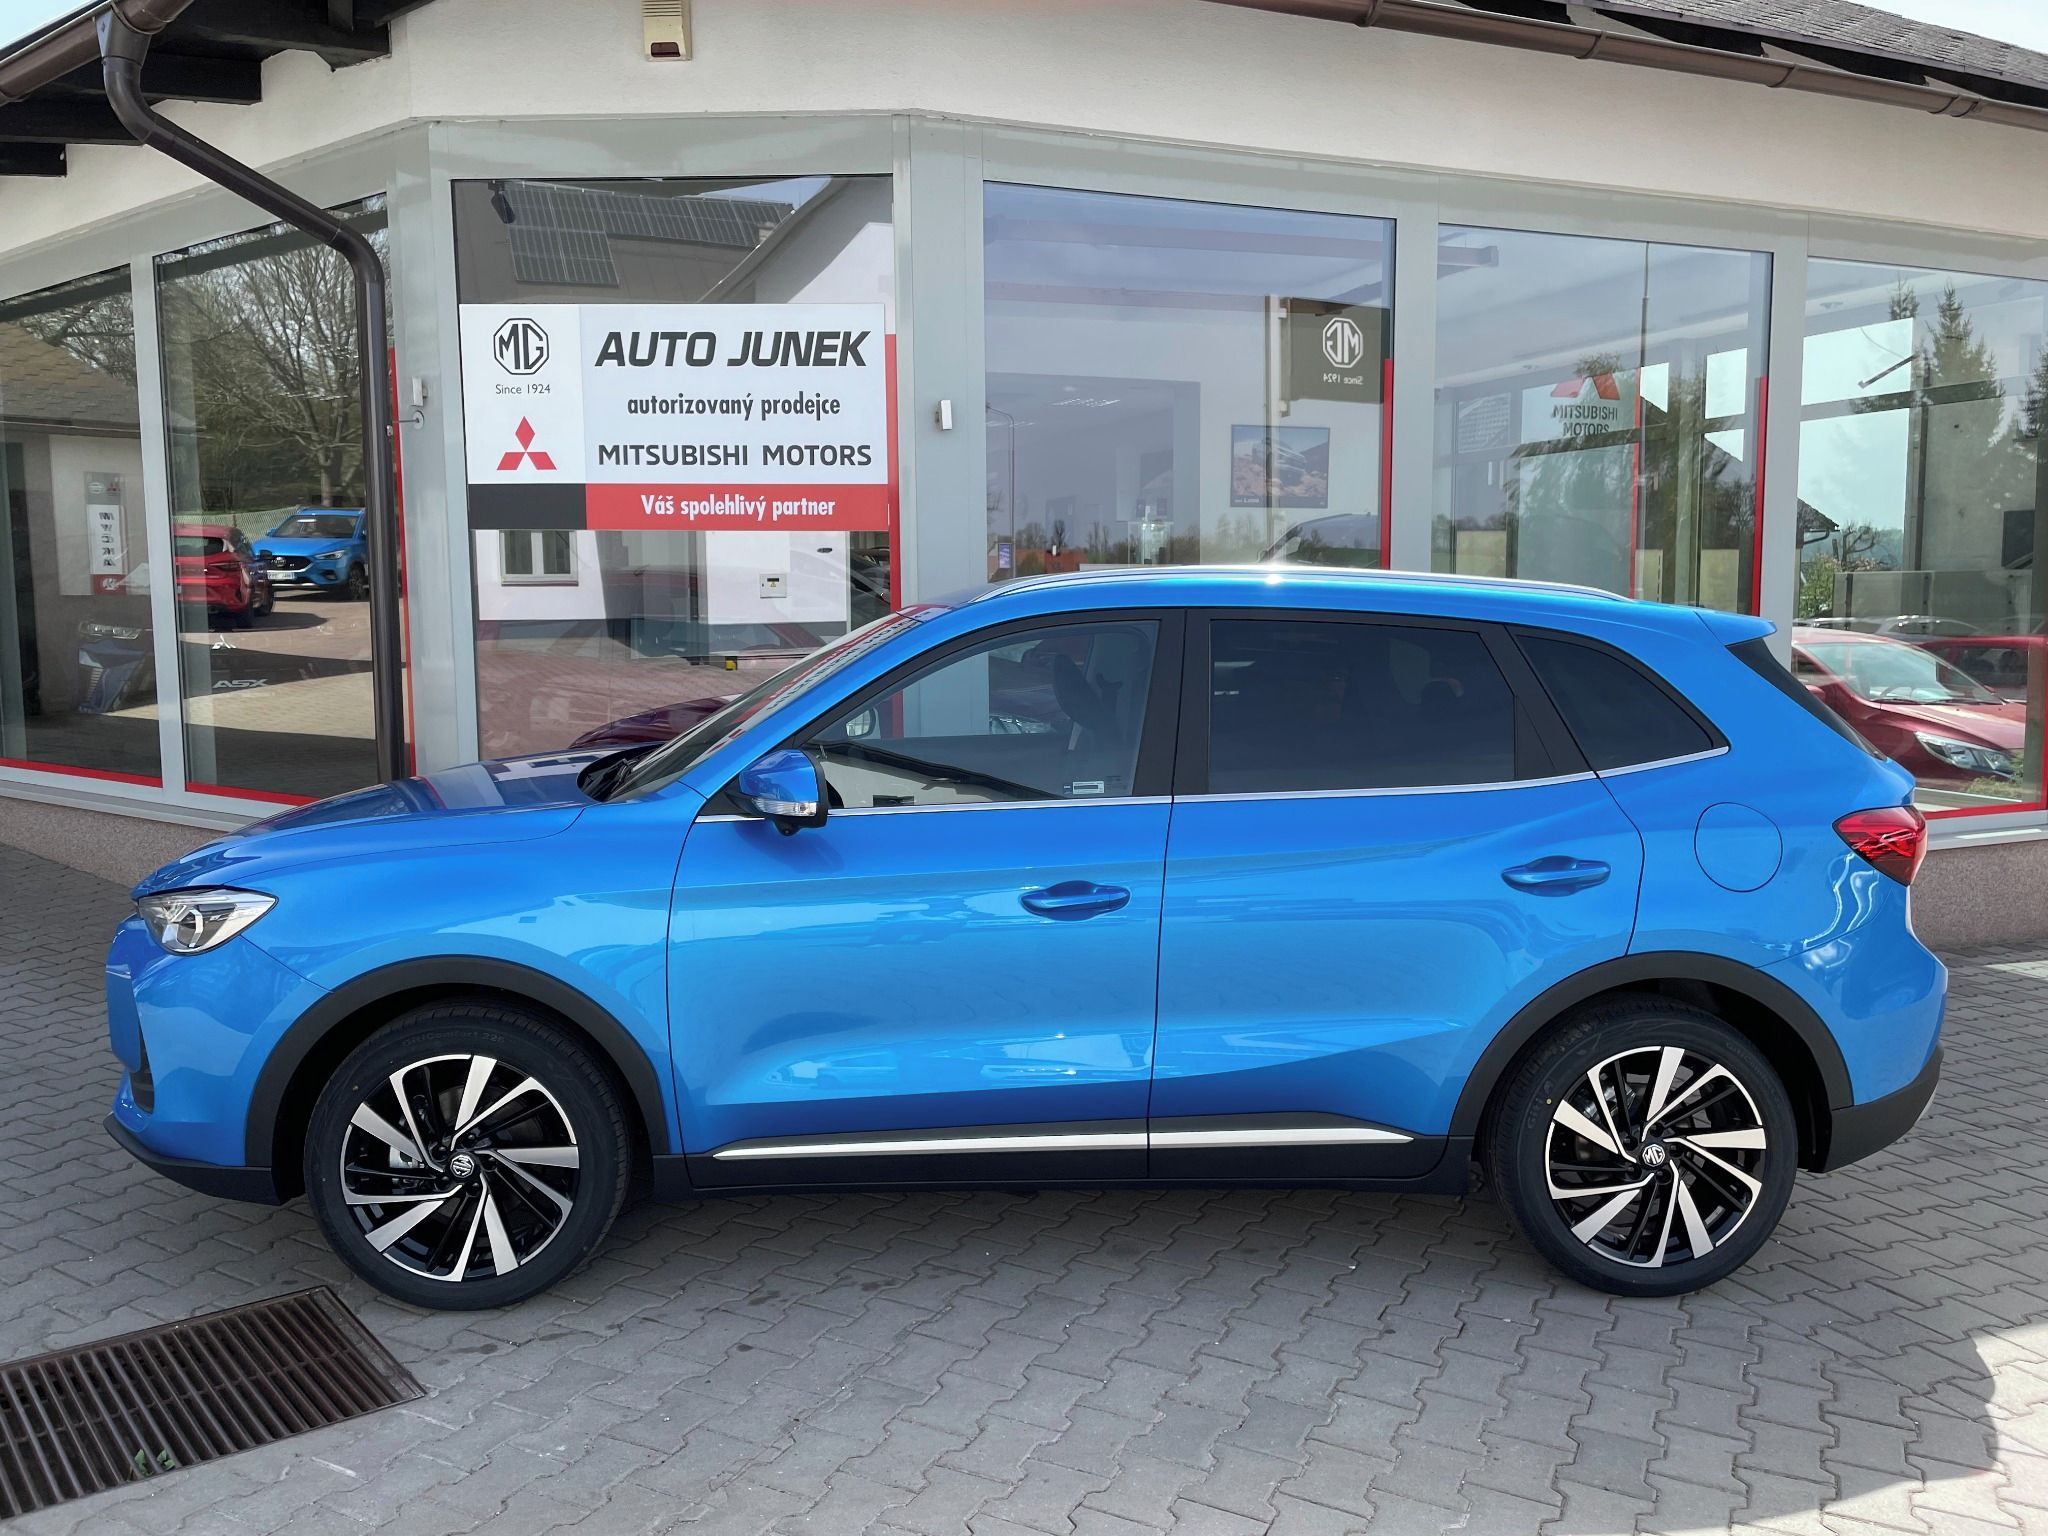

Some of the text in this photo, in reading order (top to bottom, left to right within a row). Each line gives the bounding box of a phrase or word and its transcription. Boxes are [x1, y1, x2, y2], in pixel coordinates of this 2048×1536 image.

[499, 323, 544, 370] MG
[594, 331, 871, 367] AUTO JUNEK
[495, 384, 551, 395] Since 1924
[627, 392, 840, 421] autorizovaný prodejce
[1552, 404, 1618, 420] MITSUBISHI
[598, 445, 872, 467] MITSUBISHI MOTORS
[641, 492, 836, 521] Váš spolehlivý partner
[212, 679, 268, 688] ASX
